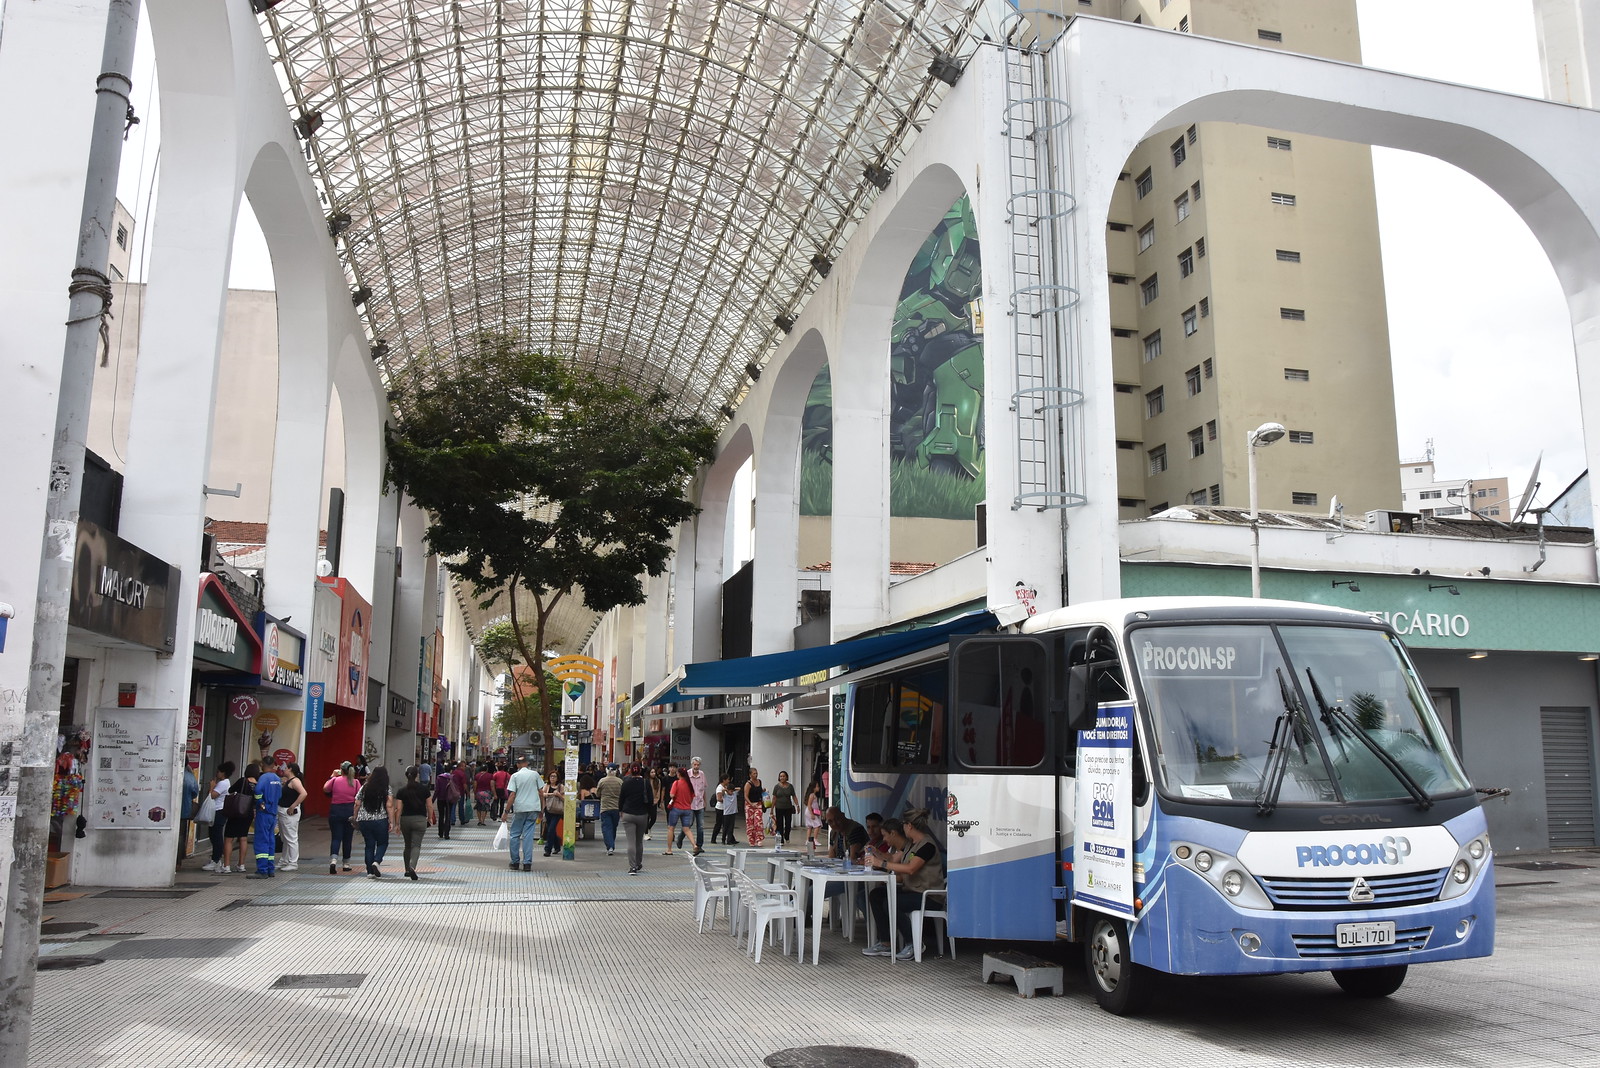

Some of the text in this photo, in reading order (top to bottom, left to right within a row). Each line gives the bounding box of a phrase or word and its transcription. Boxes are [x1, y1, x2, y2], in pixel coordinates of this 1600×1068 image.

[101, 565, 150, 610] MALORY
[1142, 646, 1236, 670] PROCON-SP
[101, 720, 121, 729] Tudo
[146, 734, 160, 746] M
[1082, 729, 1129, 740] VOCÊ TEM DIREITOS!
[1084, 753, 1094, 763] Caso
[1092, 782, 1115, 801] PRO
[1092, 799, 1114, 819] CON
[1318, 814, 1392, 825] COMIL
[1094, 878, 1107, 888] SANTO
